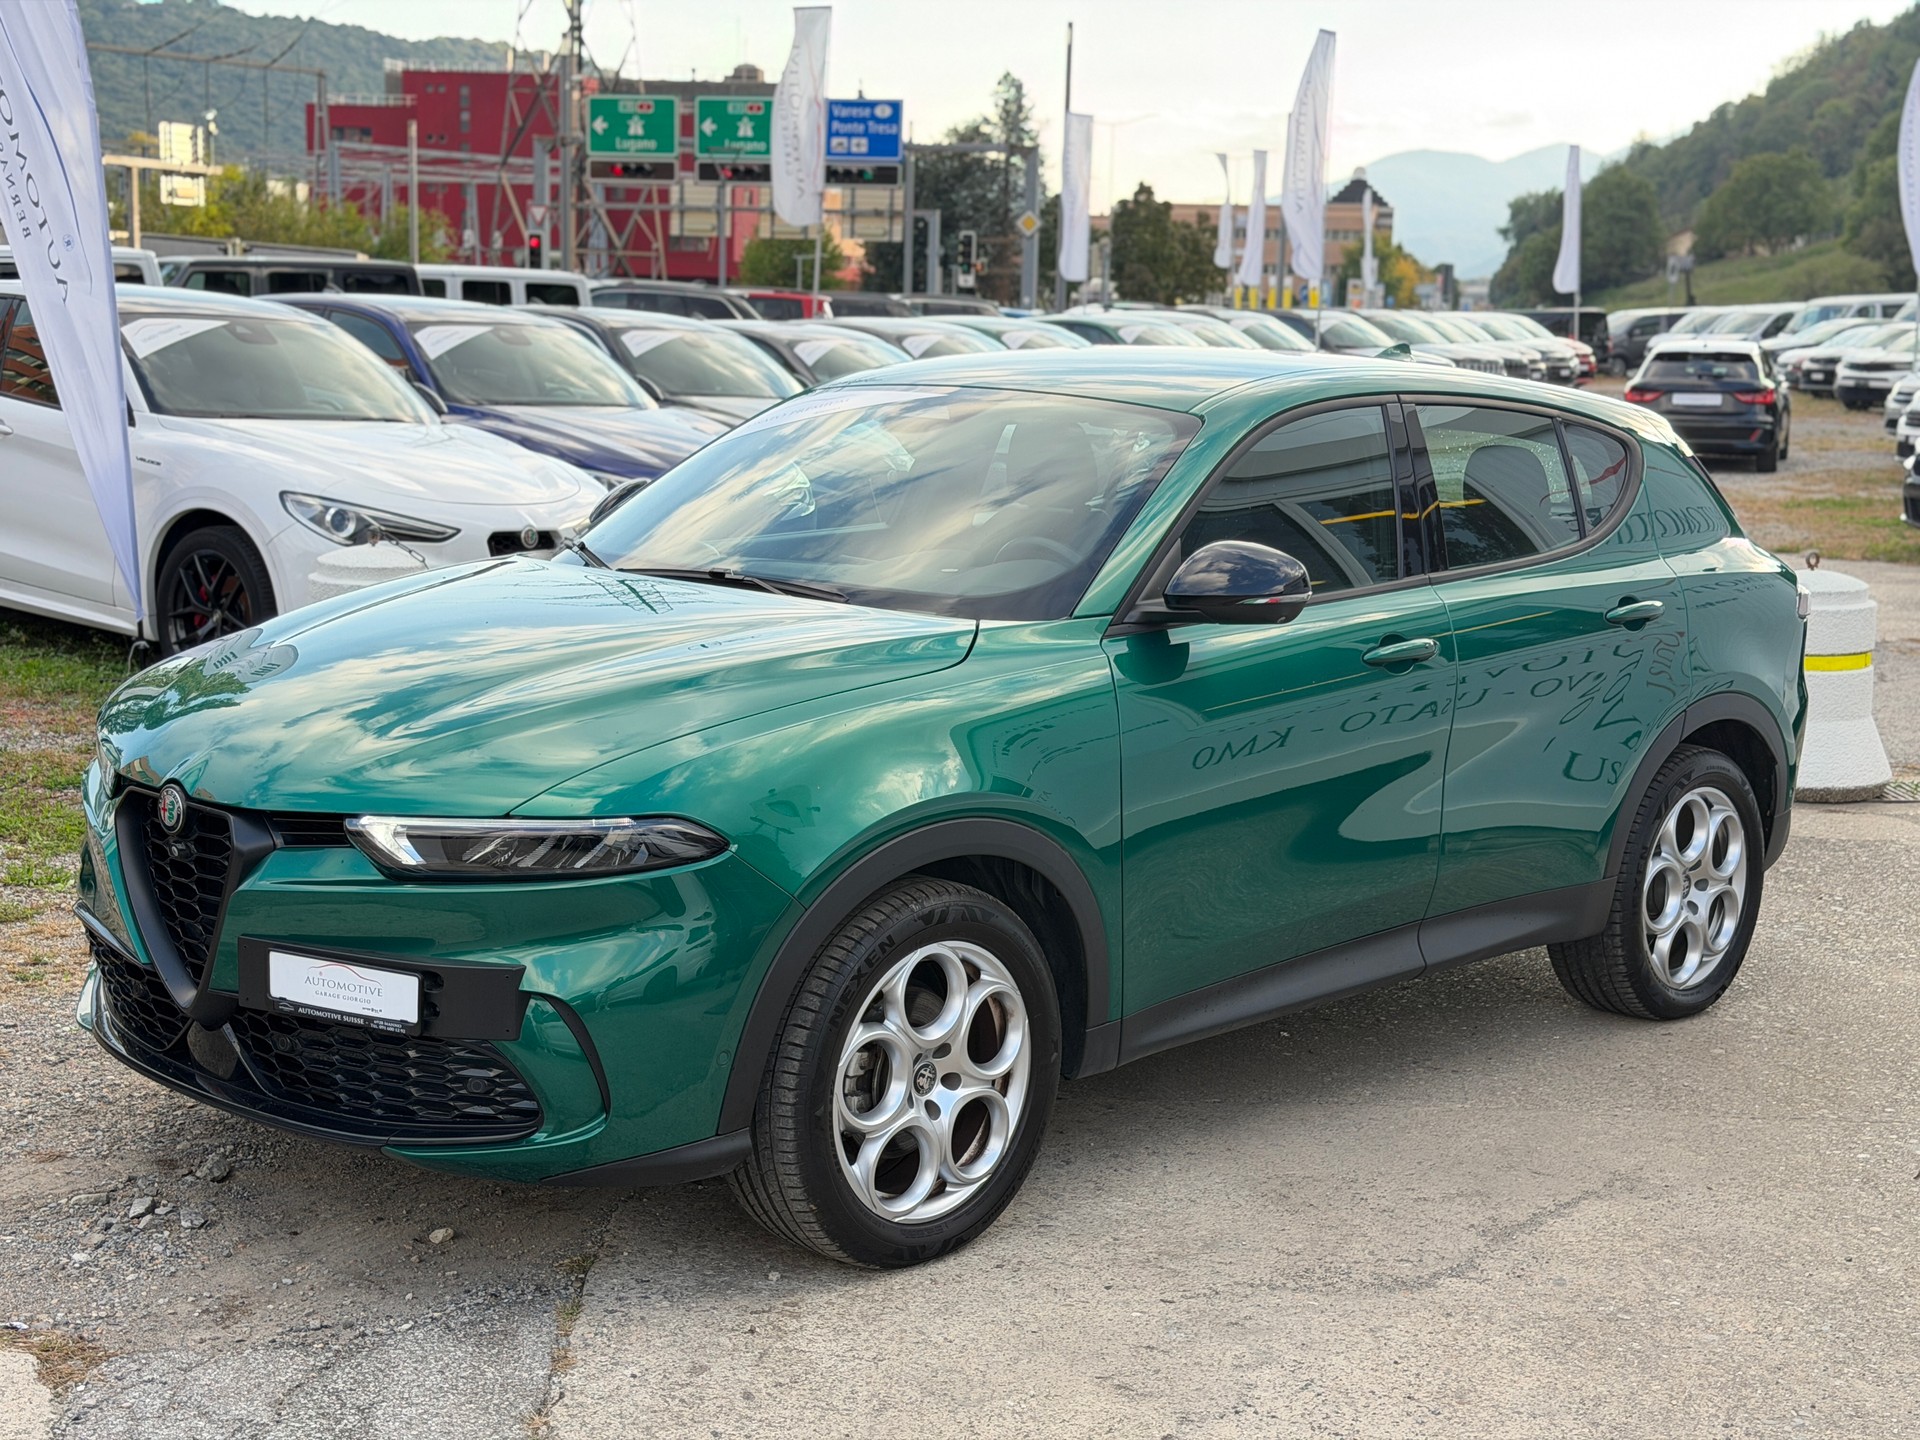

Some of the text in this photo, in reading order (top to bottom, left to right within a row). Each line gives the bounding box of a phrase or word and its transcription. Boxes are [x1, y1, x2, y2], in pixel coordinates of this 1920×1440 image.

[831, 103, 871, 118] Varese
[831, 120, 898, 135] Ponte Tresa
[615, 136, 657, 152] Lugano
[304, 975, 383, 997] AUTOMOTIVE
[829, 934, 896, 1027] NEXEN
[315, 990, 371, 1005] GARAGE GIORGIO
[298, 1007, 342, 1020] AUTOMOTIVE
[342, 1015, 364, 1025] SUISSE
